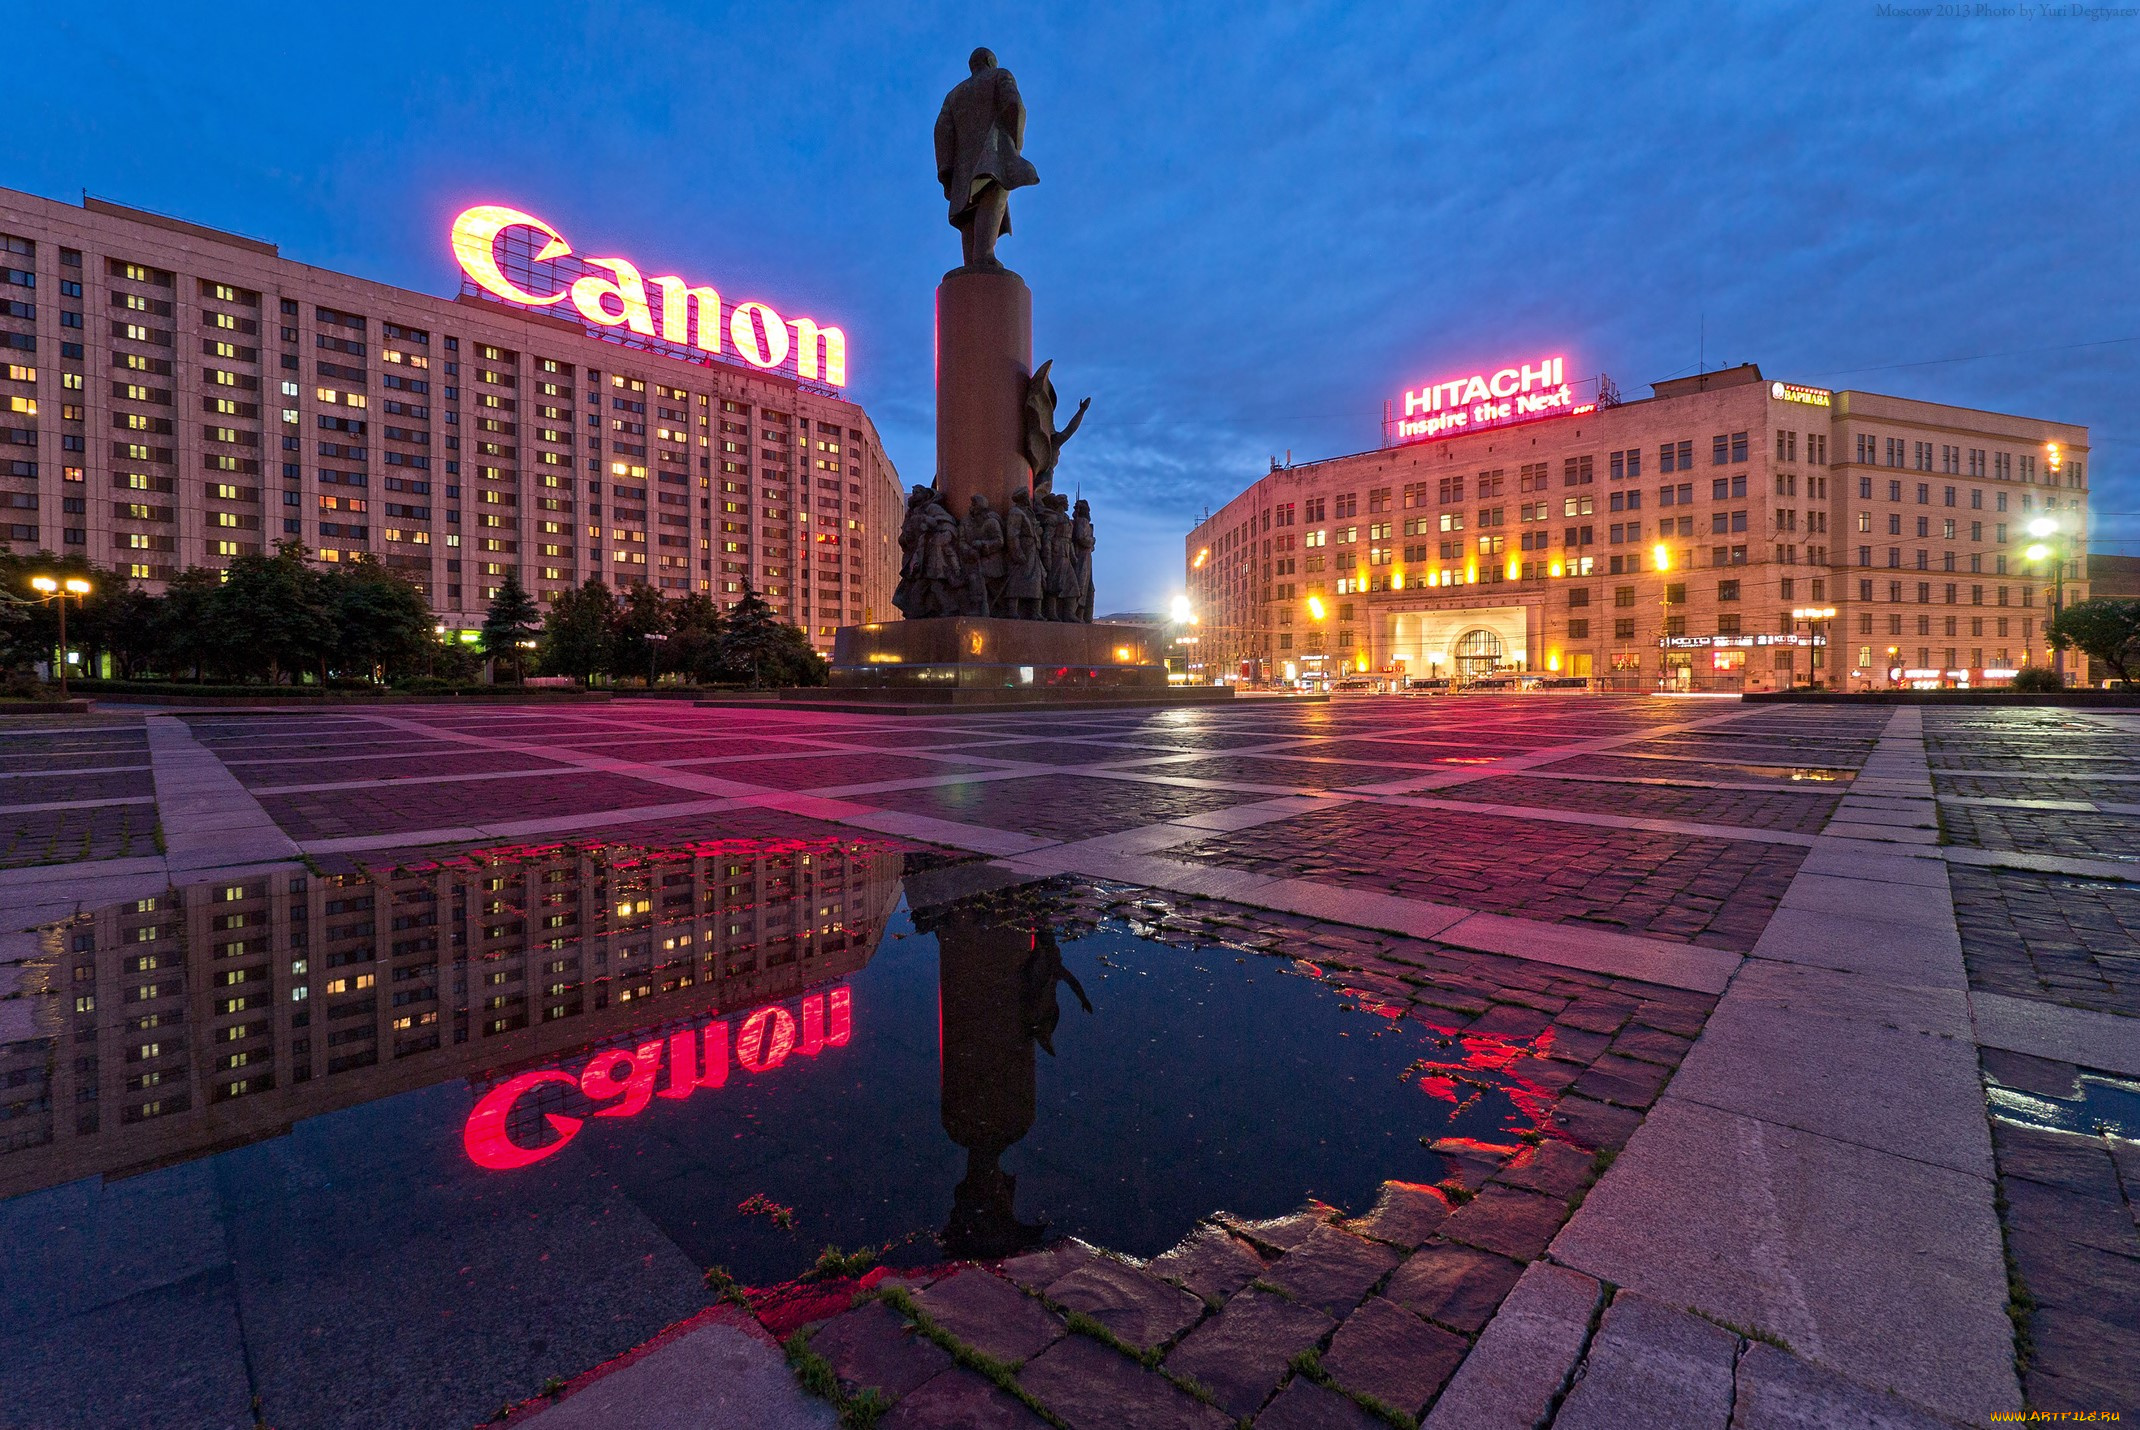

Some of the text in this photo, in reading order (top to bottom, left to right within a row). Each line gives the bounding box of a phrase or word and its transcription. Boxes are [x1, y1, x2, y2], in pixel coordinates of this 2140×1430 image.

[451, 205, 847, 388] Canon
[1398, 383, 1572, 438] Inspire the Next
[1404, 357, 1564, 417] HITACHI
